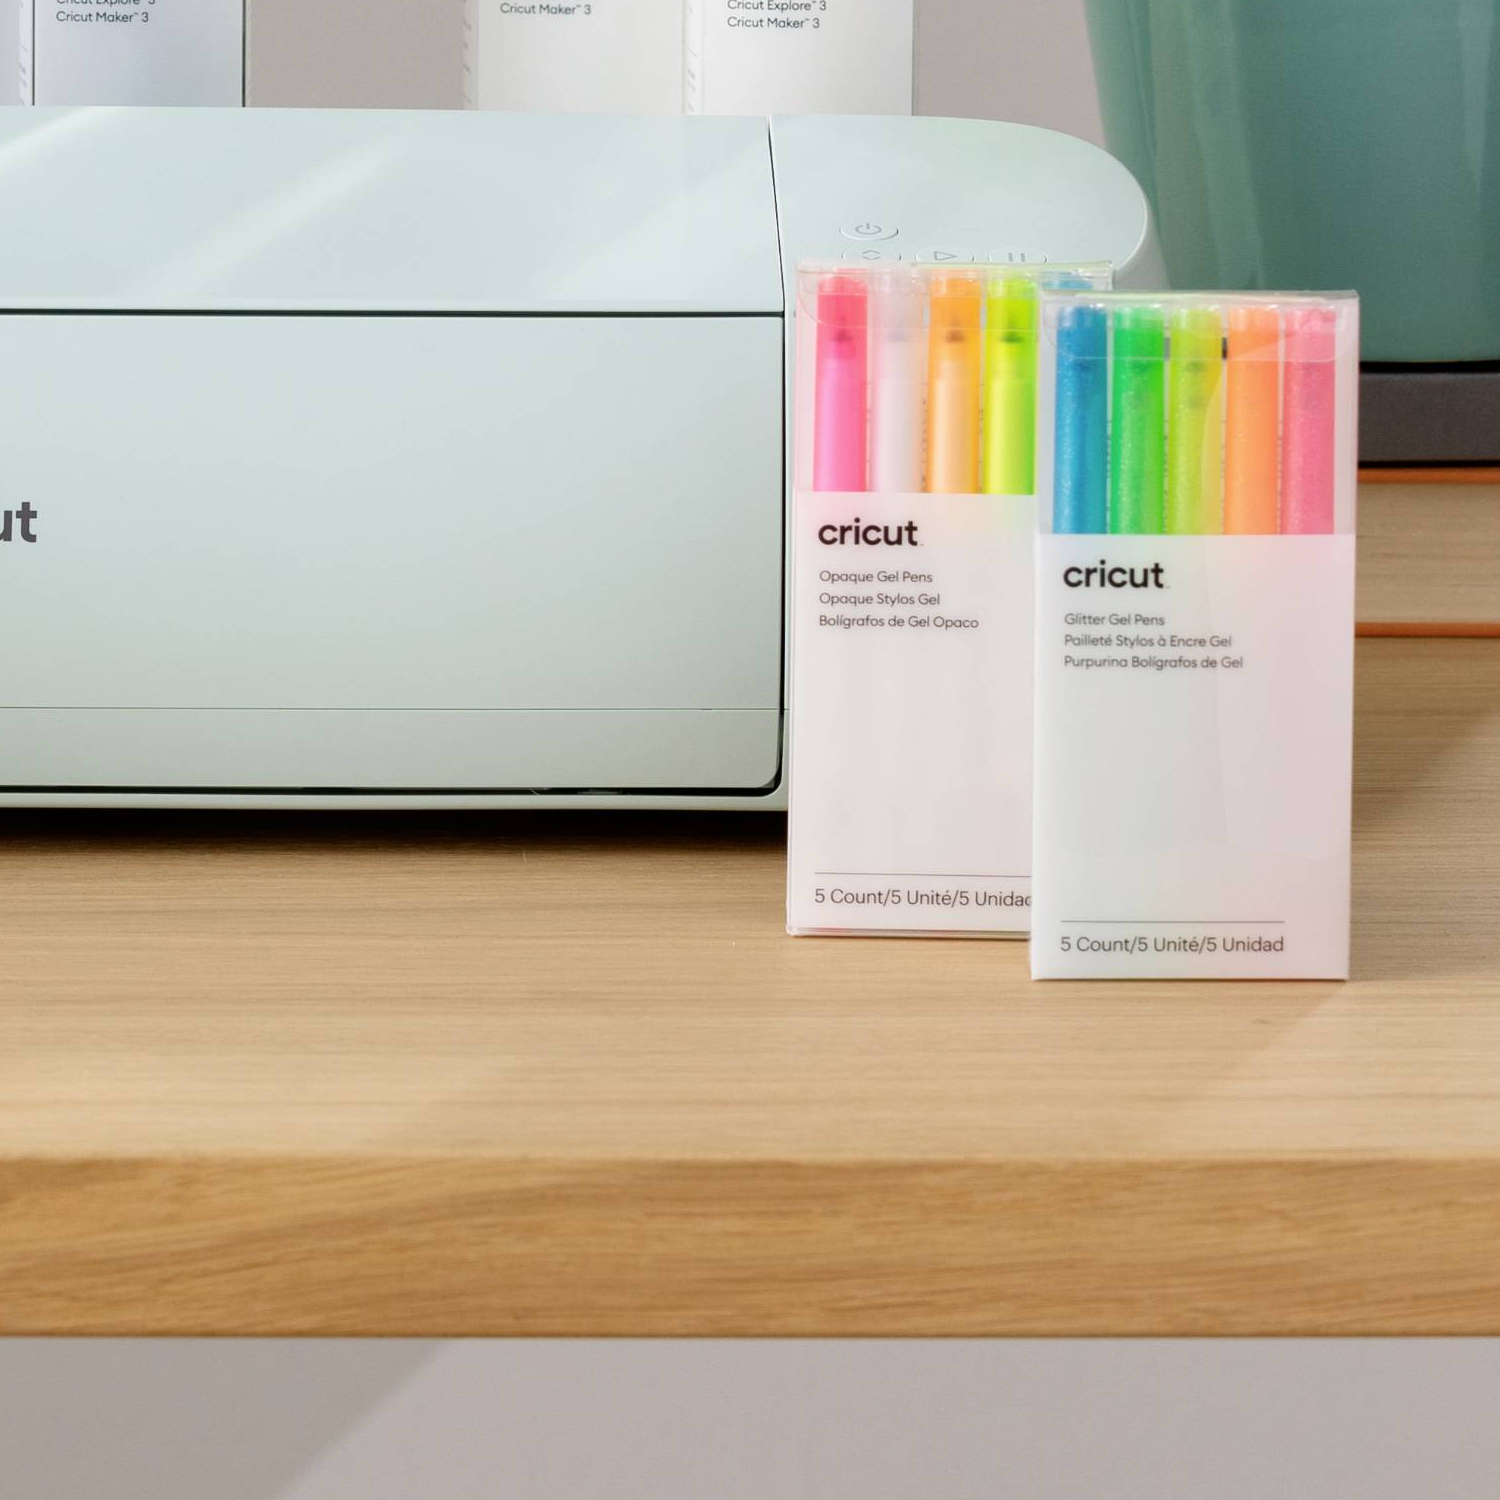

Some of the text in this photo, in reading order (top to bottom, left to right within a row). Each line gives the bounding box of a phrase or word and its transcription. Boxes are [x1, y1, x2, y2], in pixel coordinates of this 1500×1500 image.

[819, 0, 827, 11] 3
[56, 10, 93, 22] Cricut
[141, 11, 149, 23] 3
[727, 16, 764, 28] Cricut
[812, 17, 820, 29] 3
[818, 517, 918, 547] cricut
[819, 570, 933, 585] Opaque Gel Pens
[1063, 559, 1164, 589] cricut
[819, 592, 940, 608] Opaque Stylos Gel
[819, 614, 979, 631] Bolígrafos de Gel Opaco
[1064, 613, 1165, 626] Glitter Gel Pens
[1064, 634, 1232, 649] Pailleté Stylos à Encre Gel
[1064, 655, 1243, 671] Purpurina Bolígrafos de Gel
[815, 888, 825, 903] 5
[830, 888, 902, 907] Count/5
[907, 889, 970, 908] Unité/5
[1060, 935, 1284, 955] 5 Count/5 Unité/5 Unidad
